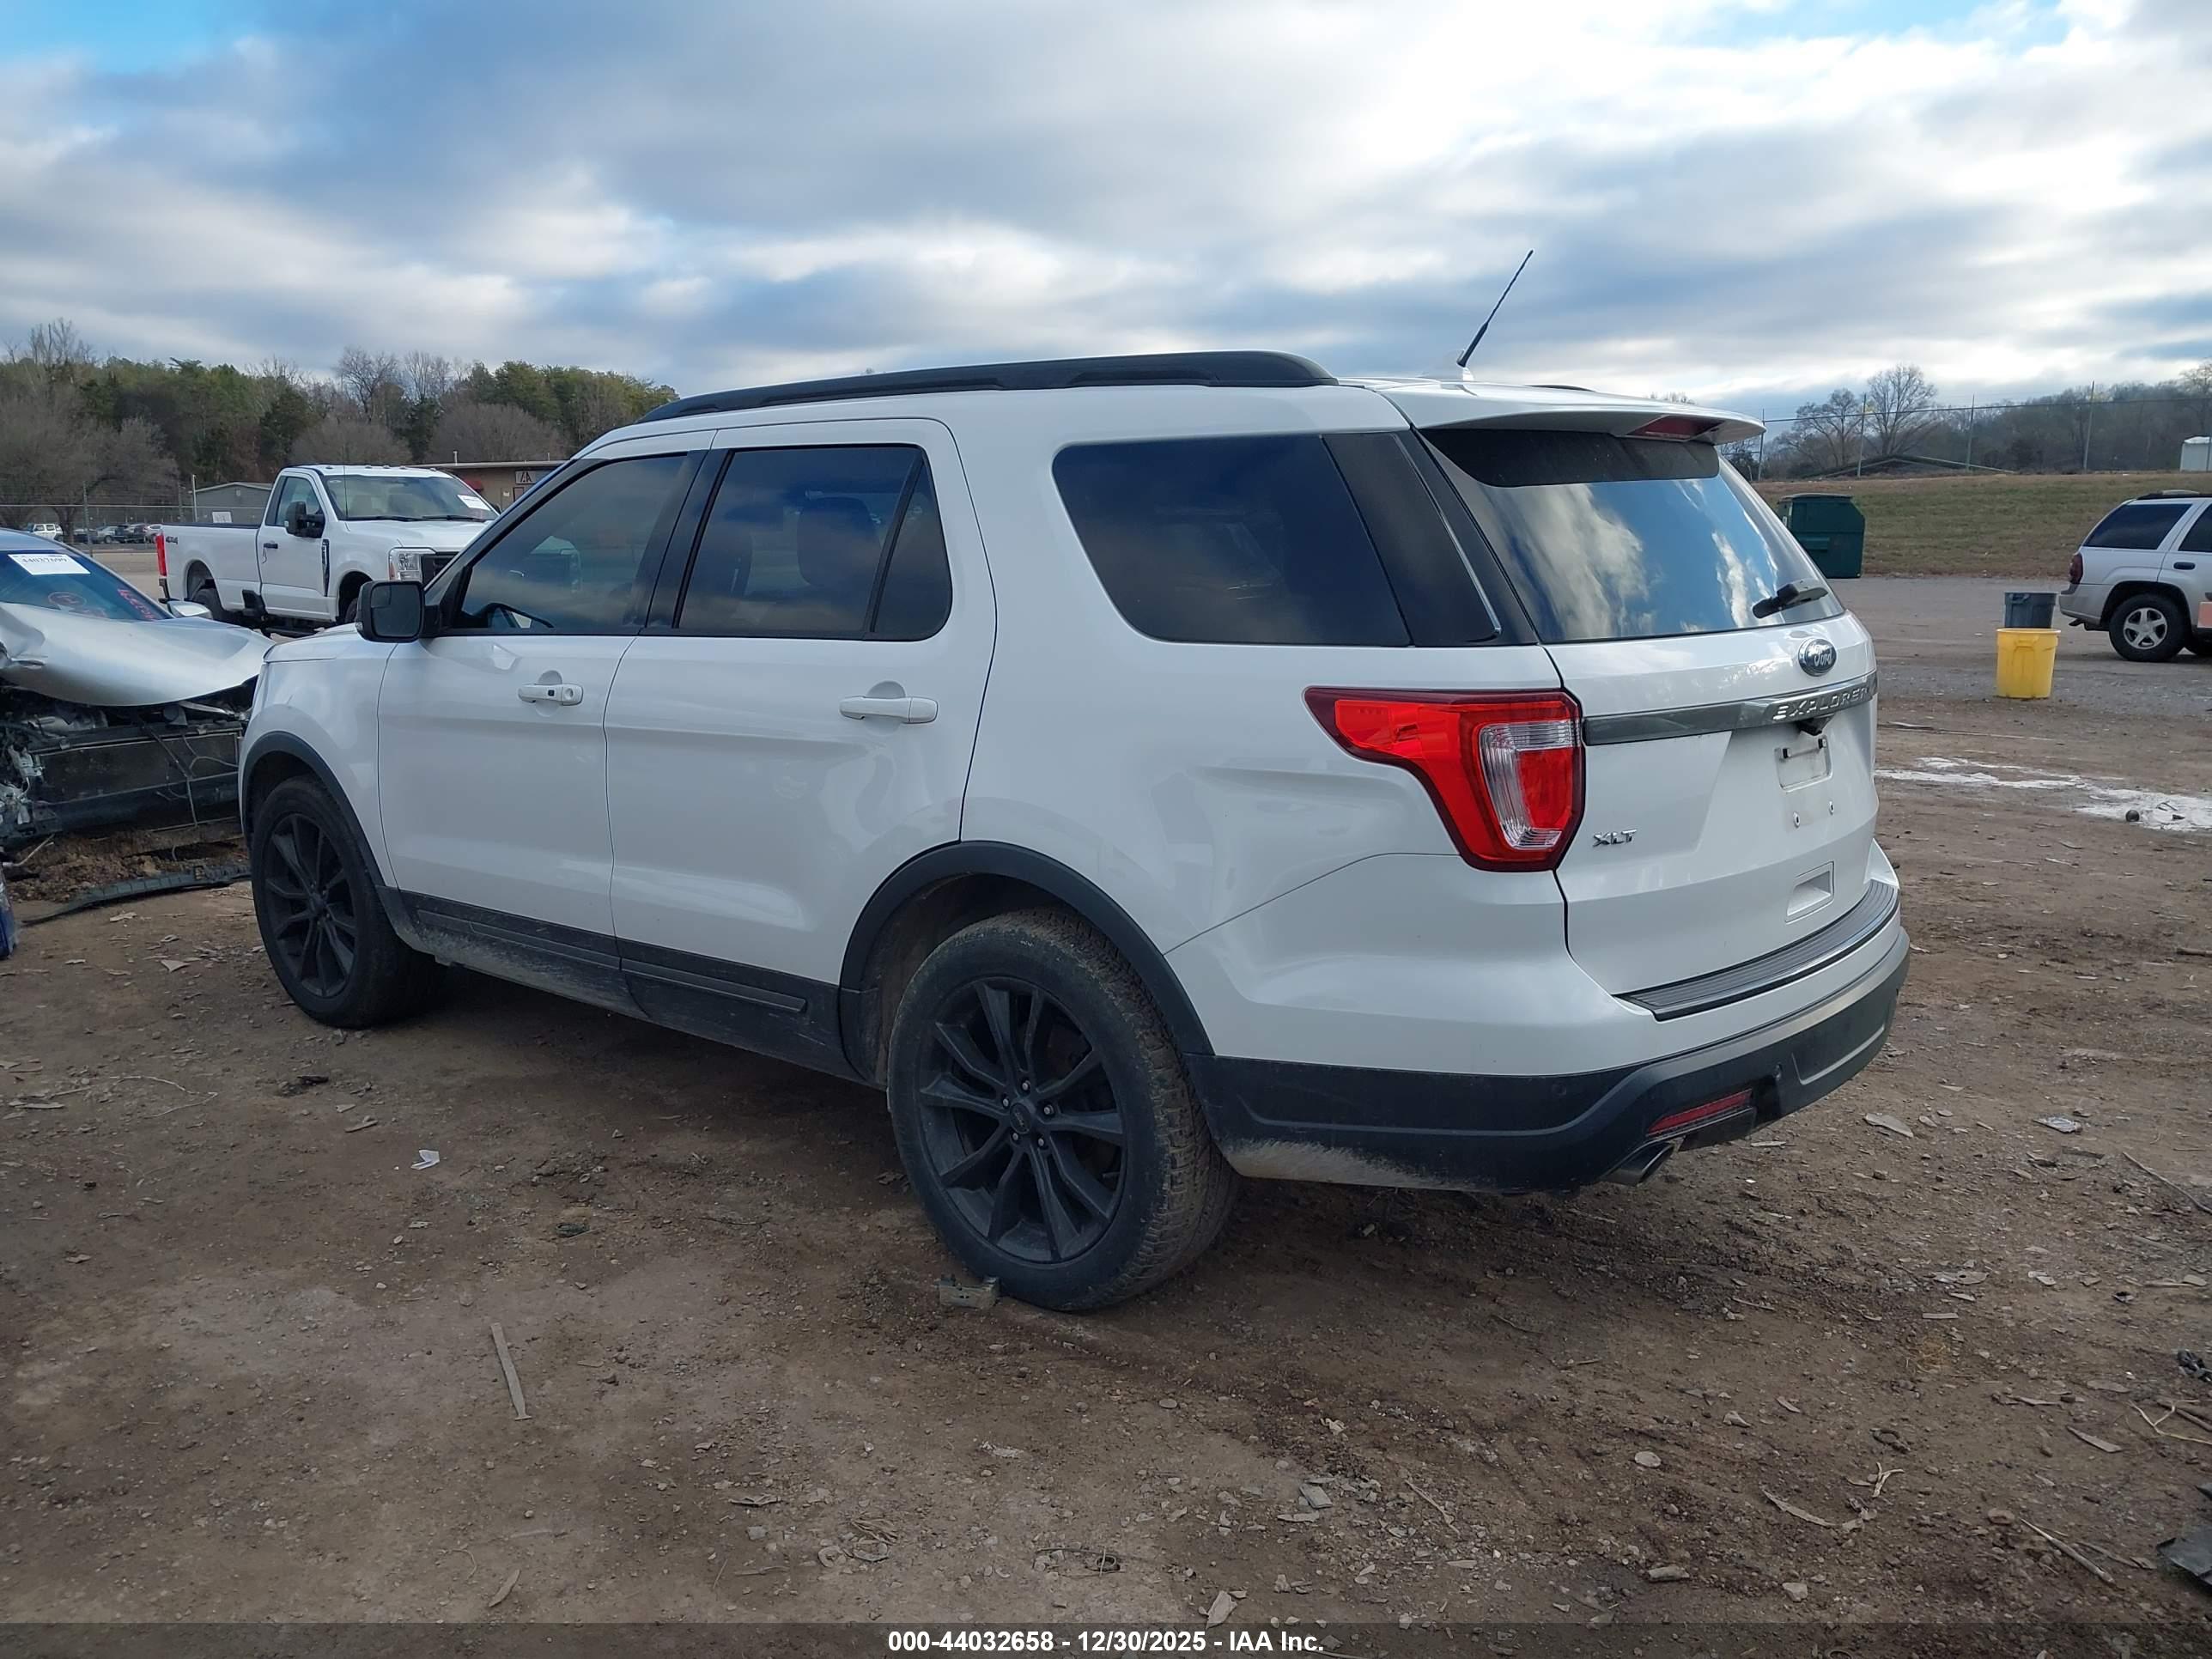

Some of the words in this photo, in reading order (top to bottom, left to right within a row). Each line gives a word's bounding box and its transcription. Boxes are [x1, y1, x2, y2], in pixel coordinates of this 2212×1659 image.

[1807, 644, 1834, 667] Ford
[1771, 687, 1869, 720] EXPLORER
[1592, 830, 1638, 848] XLT
